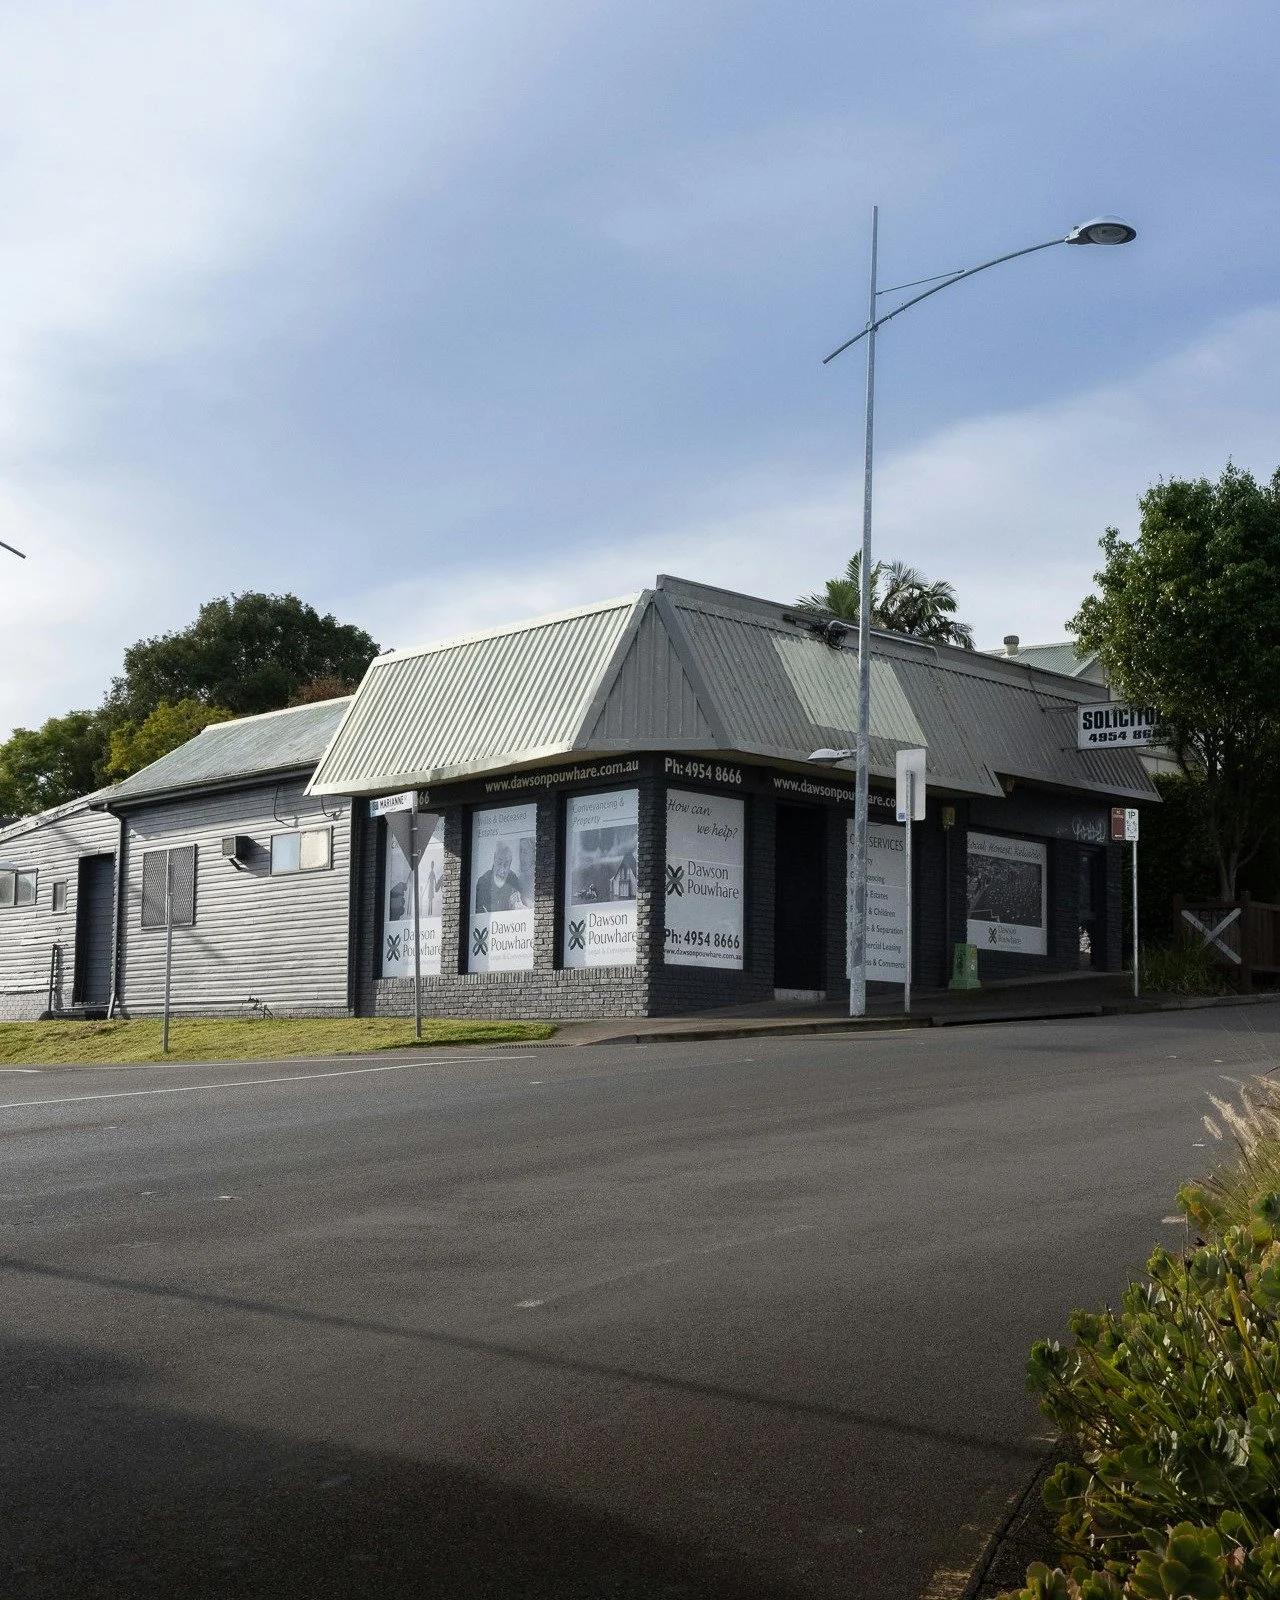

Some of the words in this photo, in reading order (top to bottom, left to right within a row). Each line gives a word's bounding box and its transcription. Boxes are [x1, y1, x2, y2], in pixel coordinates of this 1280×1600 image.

[1088, 731, 1127, 743] 4954
[485, 760, 639, 793] www.dawsonpouwhare.com.au
[664, 757, 684, 775] Ph:
[685, 760, 712, 780] 4954
[715, 764, 742, 785] 8666
[380, 795, 404, 809] MARIANNE
[667, 798, 690, 813] How
[690, 804, 712, 817] can
[1127, 811, 1136, 819] 1P
[697, 824, 710, 835] we
[710, 822, 738, 839] help?
[868, 836, 904, 852] SERVICES
[687, 860, 729, 880] Dawson
[687, 879, 740, 899] Pouwhare
[491, 920, 527, 935] Dawson
[589, 912, 628, 928] Dawson
[403, 928, 436, 942] Dason
[490, 935, 535, 951] Pouwhare
[588, 929, 638, 945] Pouwhare
[664, 928, 681, 944] Ph:
[684, 930, 710, 947] 4954
[714, 933, 740, 949] 8666
